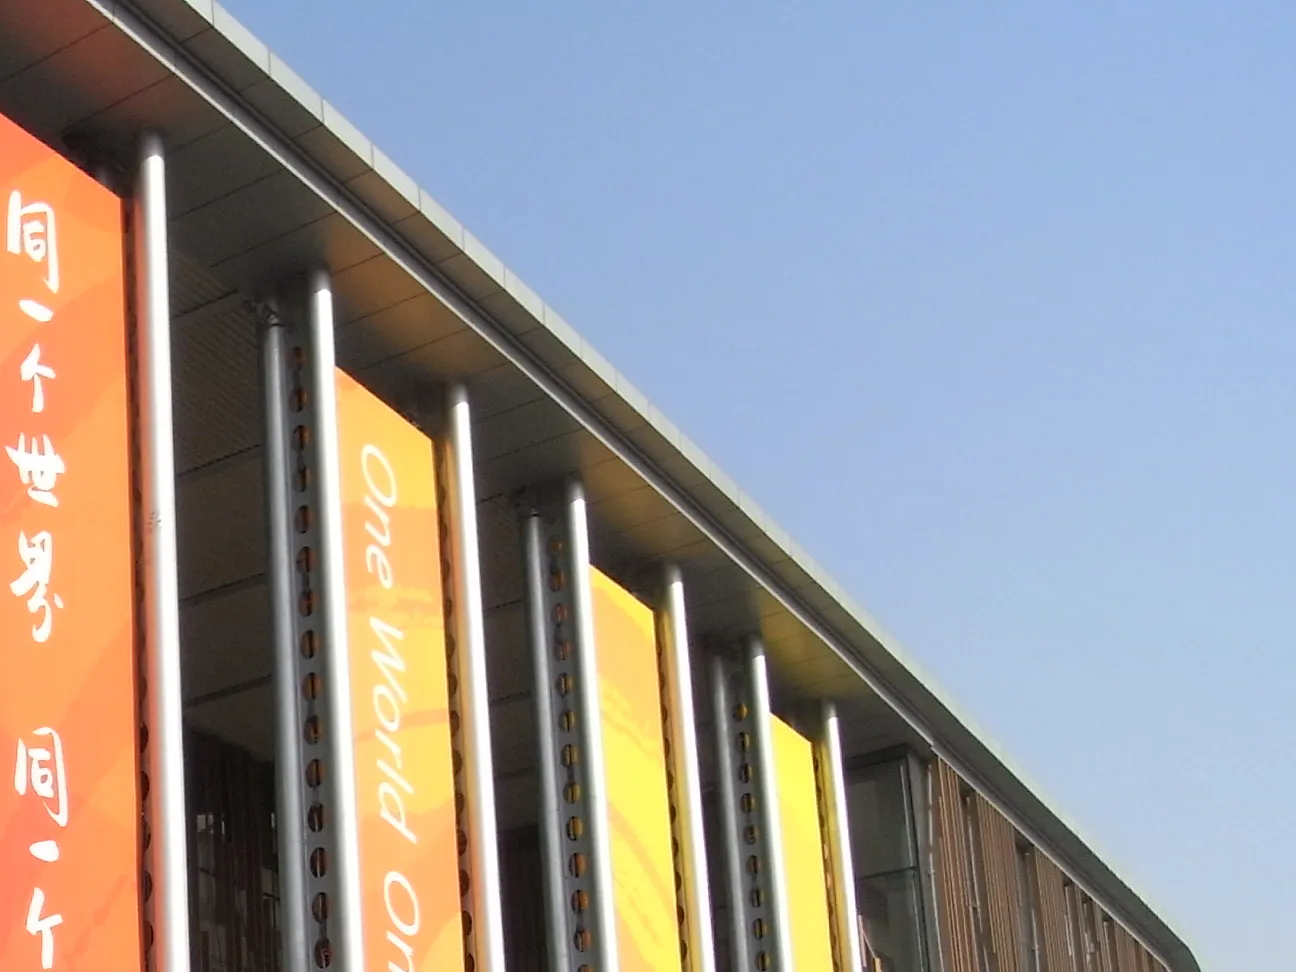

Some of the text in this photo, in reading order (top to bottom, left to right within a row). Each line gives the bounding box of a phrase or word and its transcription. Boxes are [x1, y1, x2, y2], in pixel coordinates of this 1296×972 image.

[6, 191, 65, 642] 同一个世界
[361, 444, 398, 589] One
[369, 617, 418, 844] World
